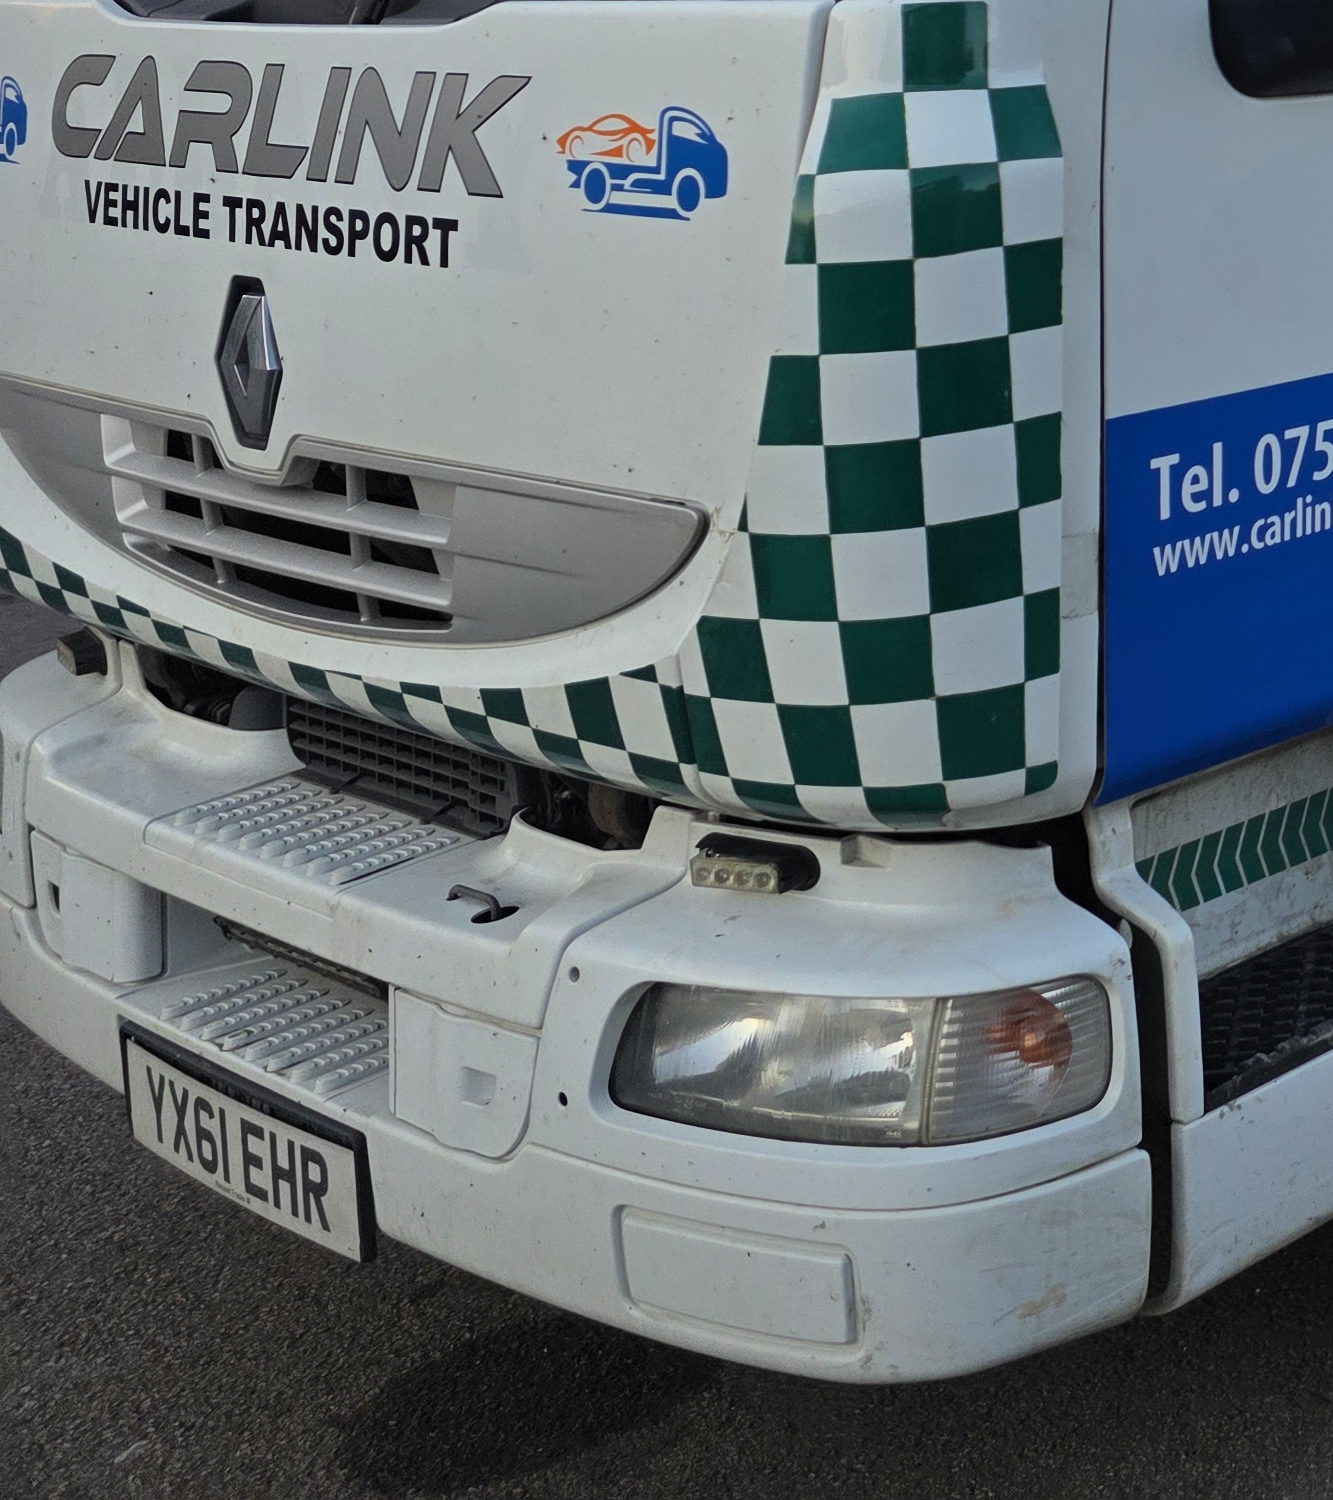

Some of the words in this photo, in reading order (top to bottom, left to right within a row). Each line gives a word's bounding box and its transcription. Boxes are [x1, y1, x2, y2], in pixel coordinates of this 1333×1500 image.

[51, 53, 533, 198] CARLINK
[83, 179, 211, 240] VEHICLE
[222, 195, 459, 269] TRANSPORT
[1150, 441, 1240, 521] Tel.
[145, 1064, 231, 1185] YX61
[240, 1116, 332, 1234] EHR
